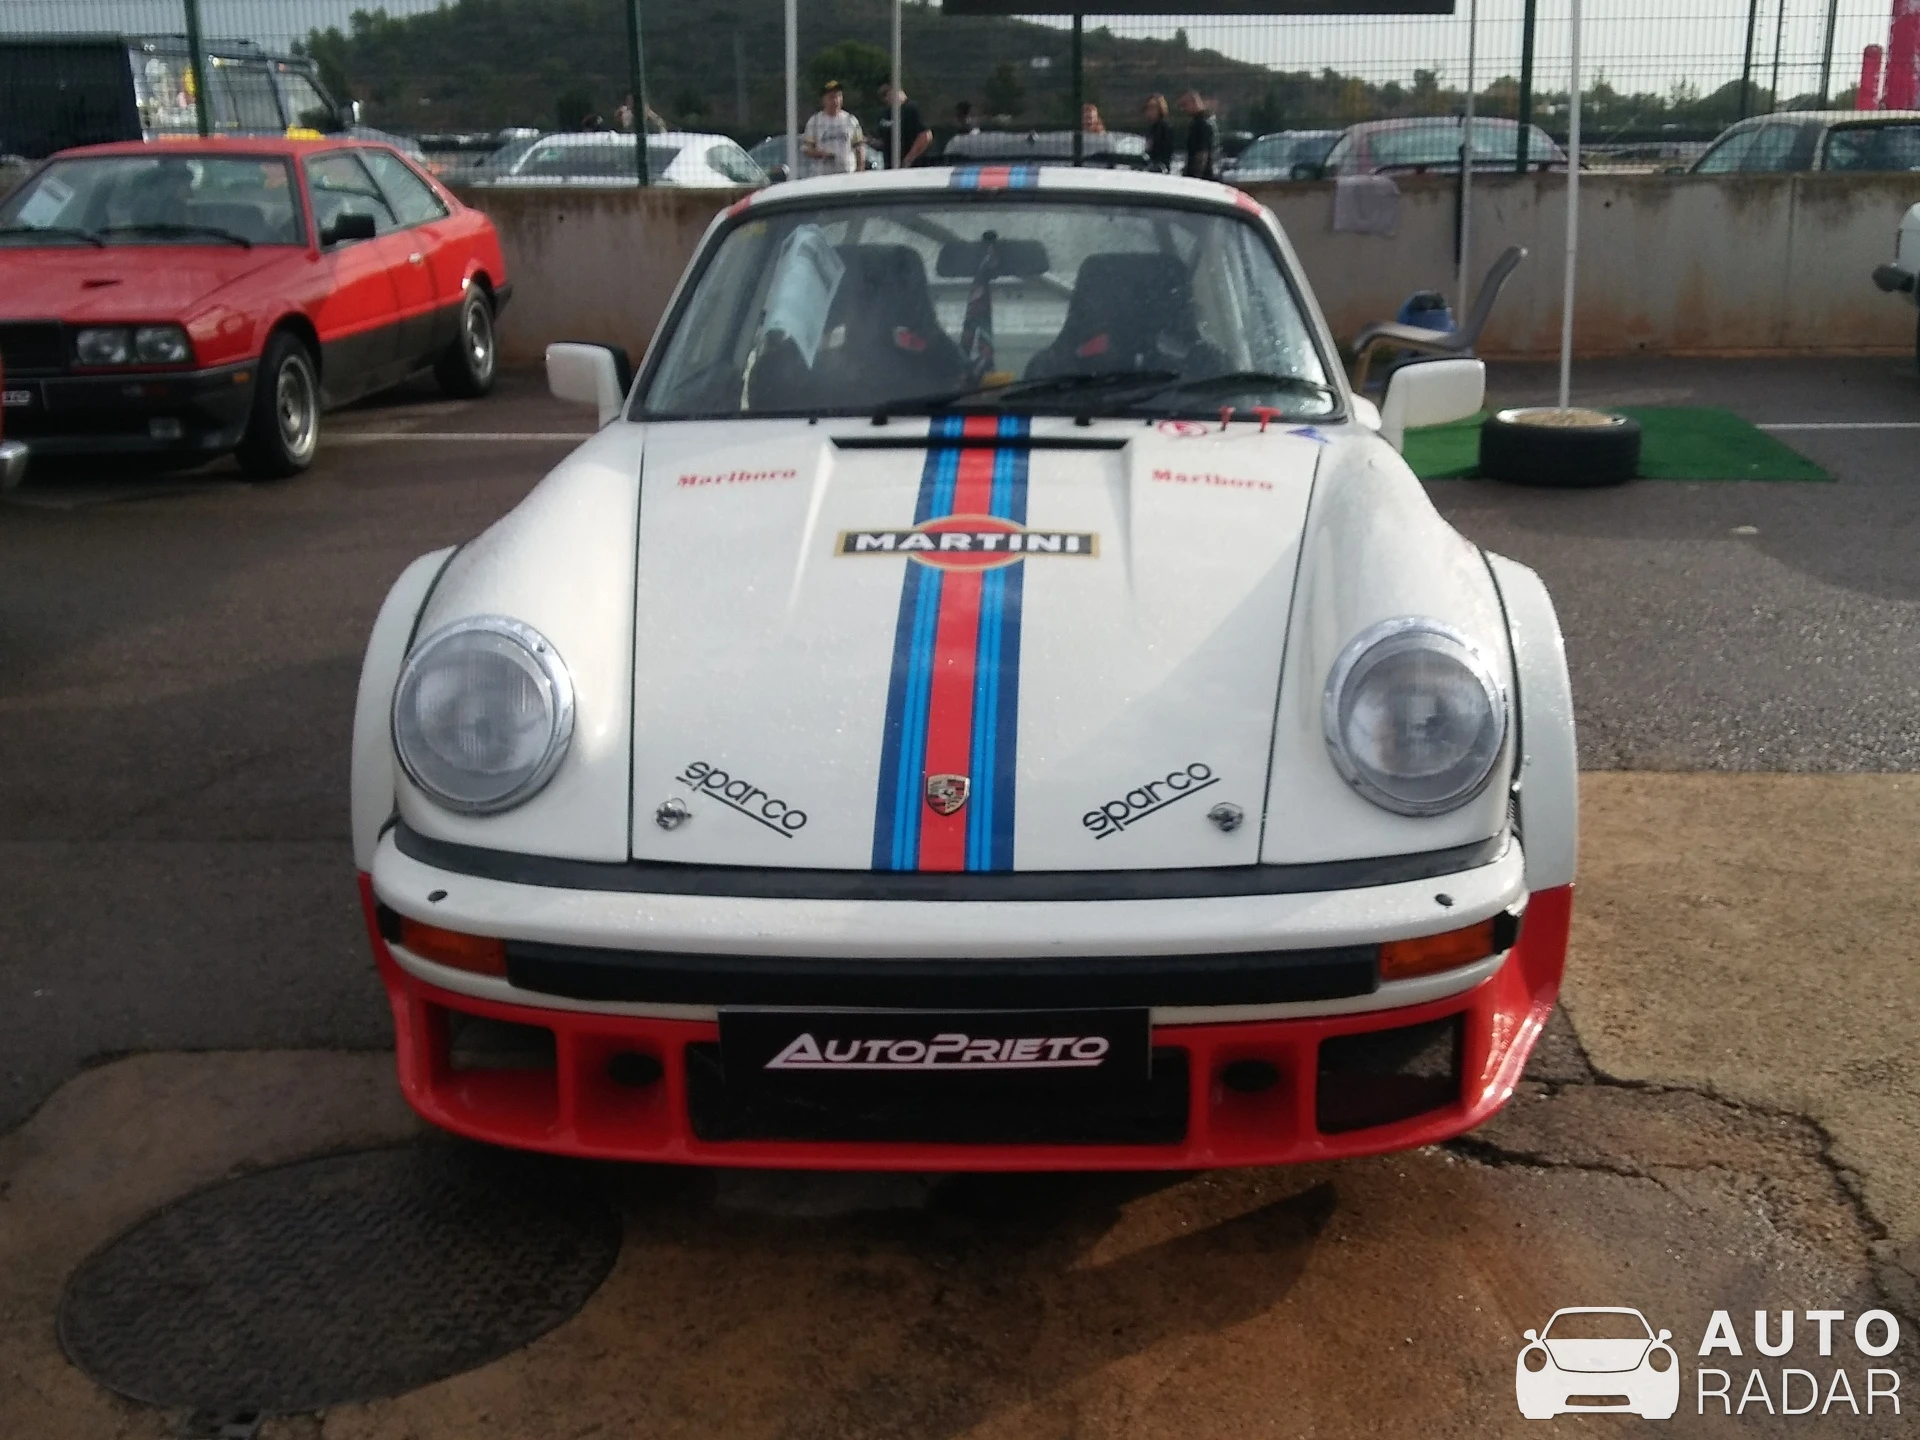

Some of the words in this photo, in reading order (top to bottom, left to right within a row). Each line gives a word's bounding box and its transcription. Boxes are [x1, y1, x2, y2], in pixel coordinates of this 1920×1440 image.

[677, 469, 797, 487] Marlboro
[1152, 469, 1274, 492] Marlboro
[855, 533, 1080, 552] MARTINI
[684, 761, 808, 831] sparco
[1082, 762, 1212, 832] sparco
